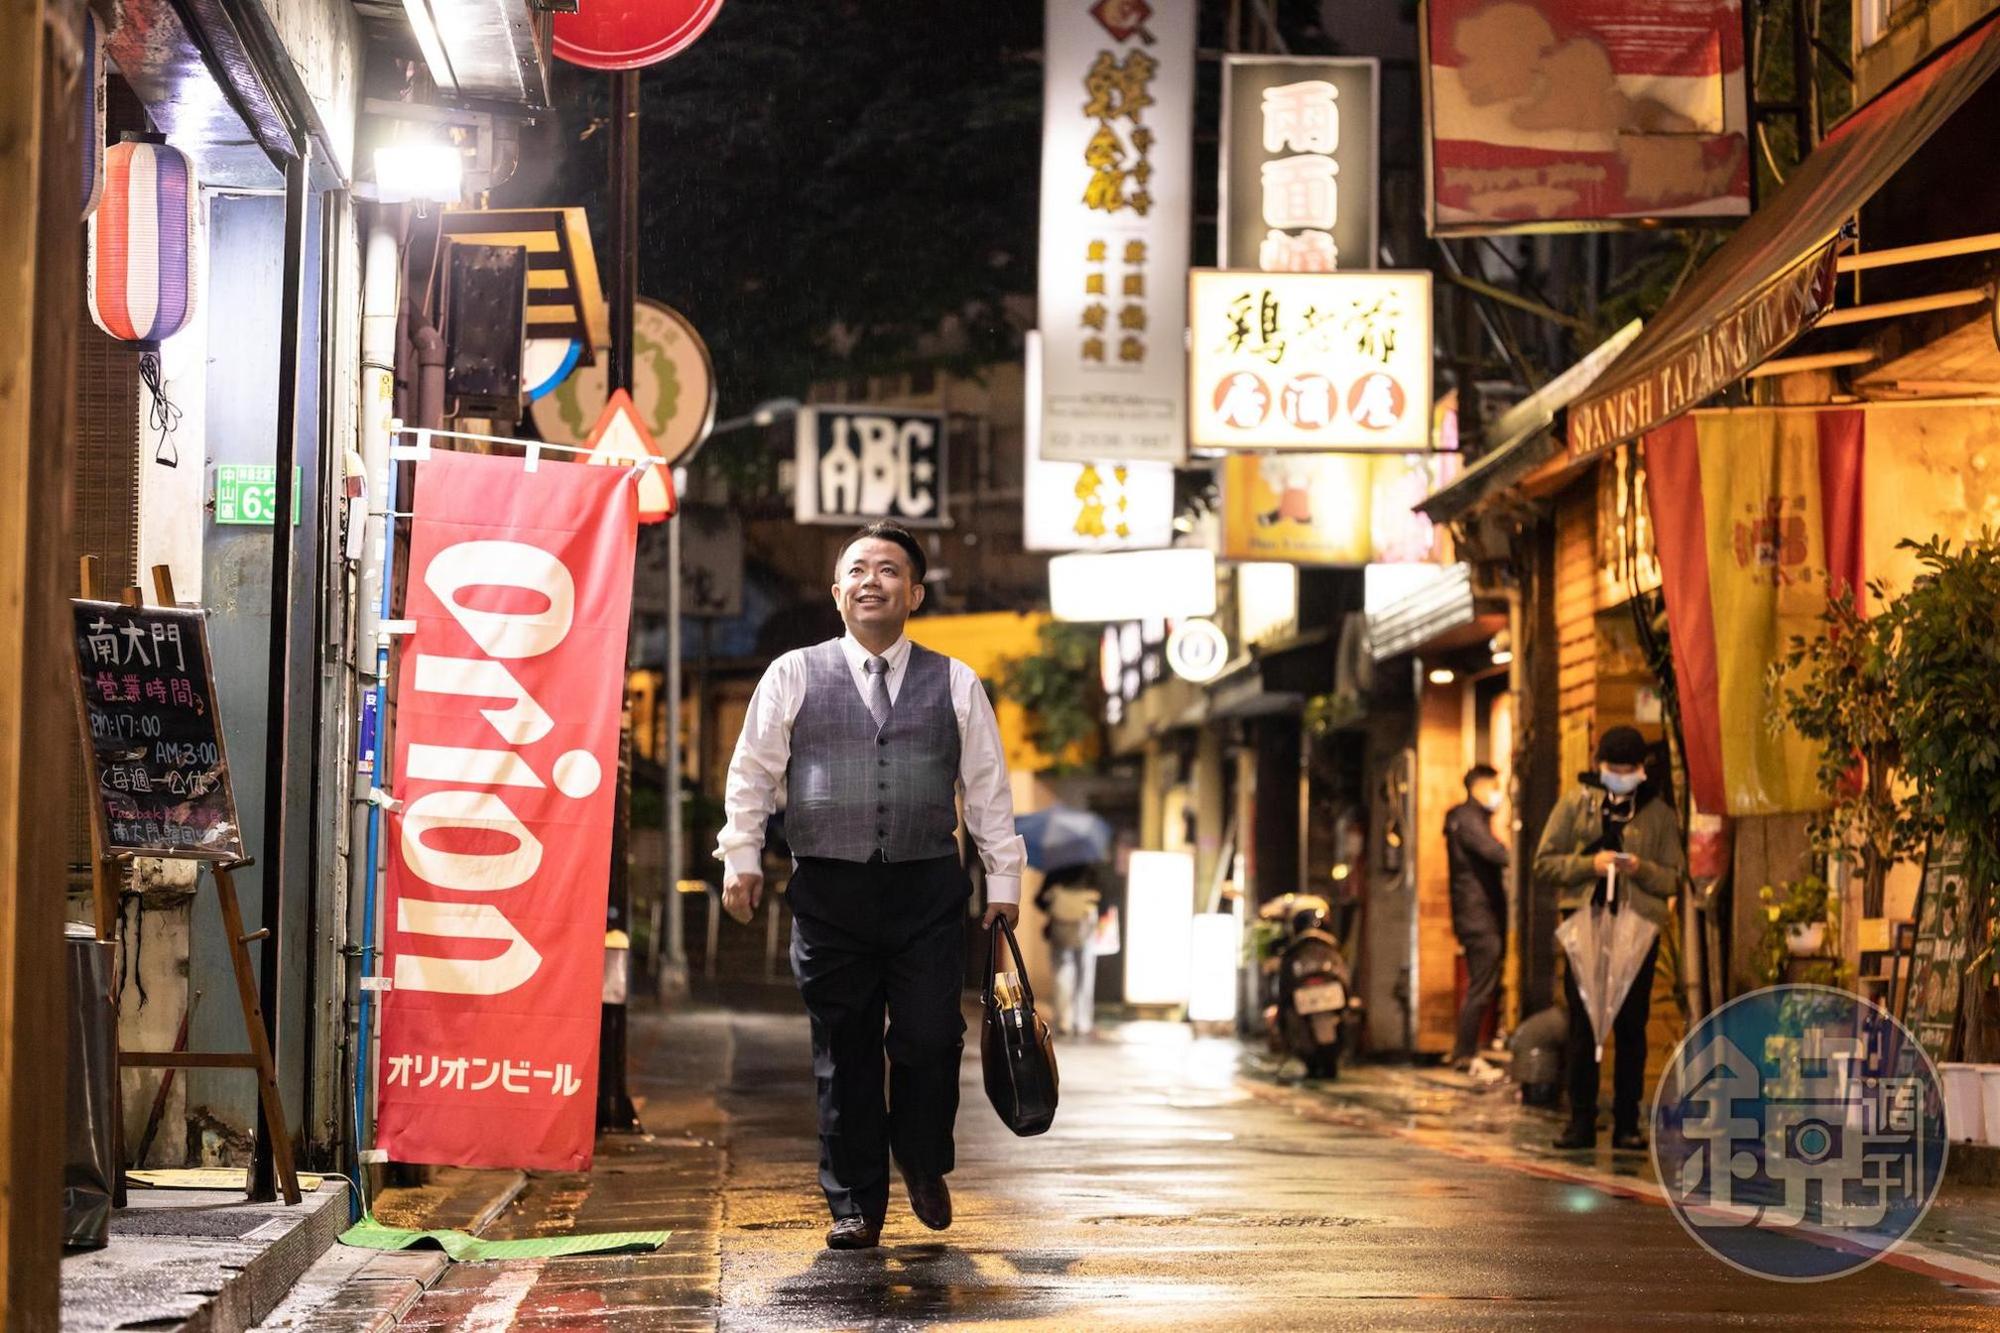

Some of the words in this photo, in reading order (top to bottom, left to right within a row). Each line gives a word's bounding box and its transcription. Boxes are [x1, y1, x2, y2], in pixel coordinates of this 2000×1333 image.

[1573, 378, 1652, 456] SPANISH
[819, 414, 935, 517] ABC
[86, 617, 185, 672] 南大門
[96, 673, 193, 708] 營業時間
[387, 1054, 582, 1097] オリオンビール
